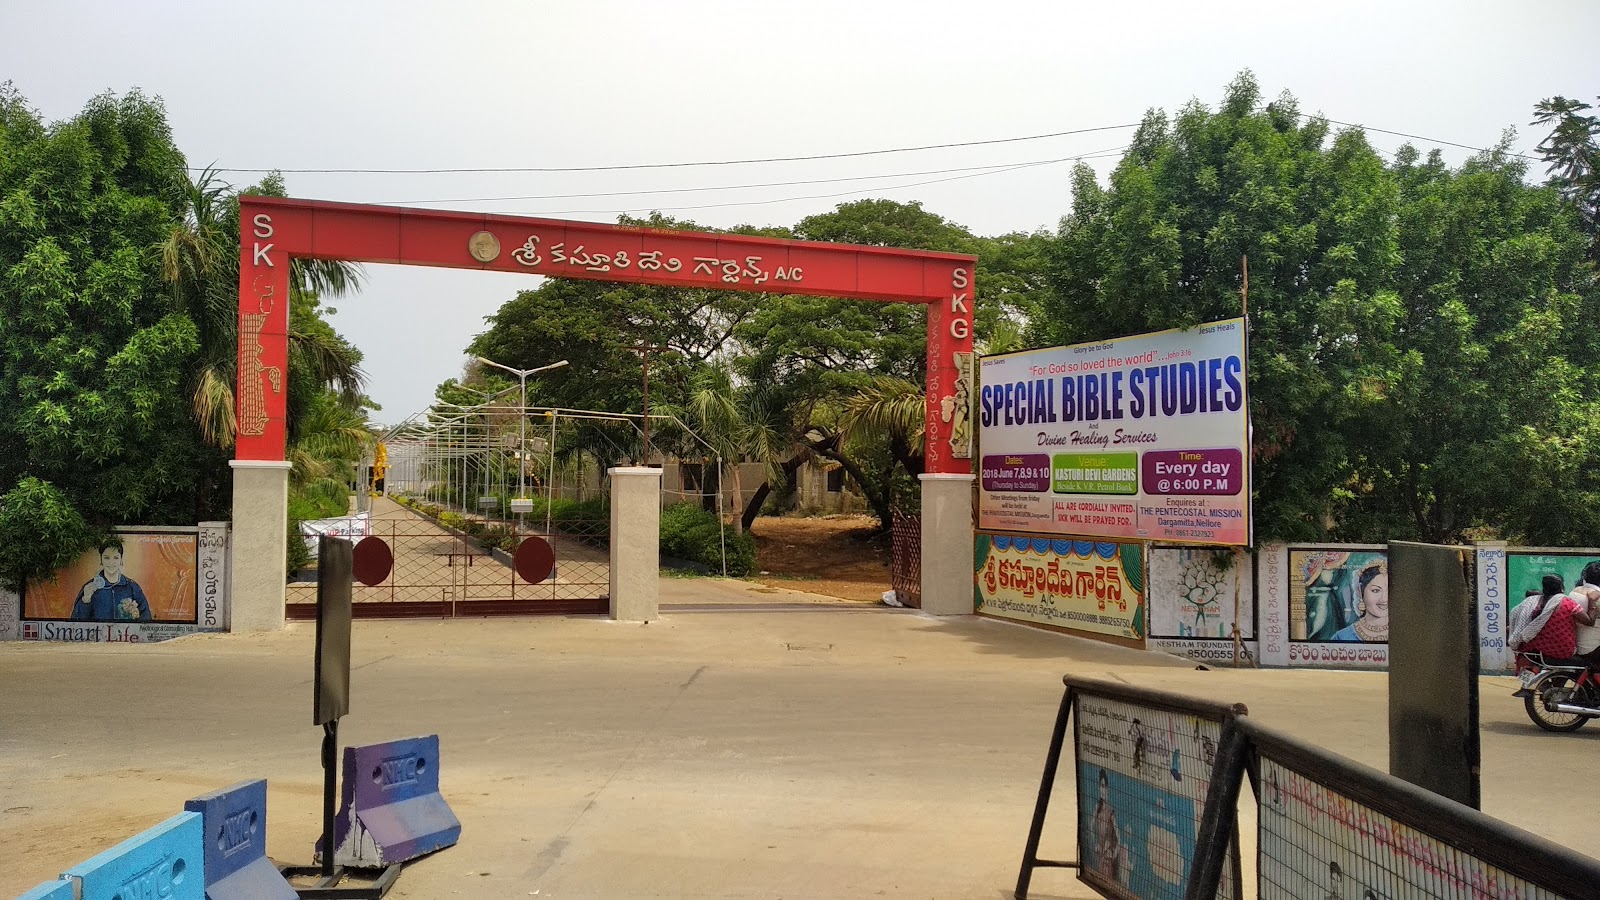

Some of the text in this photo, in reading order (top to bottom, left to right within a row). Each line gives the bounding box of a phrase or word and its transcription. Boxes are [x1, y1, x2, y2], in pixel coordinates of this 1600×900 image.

[511, 235, 542, 266] శ్రీ
[774, 266, 803, 281] A/C
[1199, 323, 1235, 335] Jesus Heals
[1074, 347, 1087, 355] Glory
[1048, 362, 1066, 374] God
[1069, 363, 1078, 372] so
[1081, 358, 1105, 371] loved
[1107, 357, 1123, 367] the
[1181, 349, 1192, 357] 3:16
[982, 355, 1242, 427] SPECIAL BIBLE STUDIES
[1037, 428, 1158, 449] Divine Healing Services
[1179, 452, 1204, 460] Time:
[982, 469, 999, 479] 2018
[999, 468, 1013, 479] June
[1039, 467, 1050, 479] 10
[1155, 460, 1230, 476] Every day
[1055, 468, 1136, 482] KASTURI DEVI GARDENS
[1097, 482, 1114, 491] Petrol
[1157, 479, 1228, 492] @ 6:00 P.M
[1055, 501, 1065, 510] ALL
[1066, 502, 1077, 511] ARE
[1078, 503, 1109, 512] CORDIALLY
[1166, 497, 1197, 507] Enquires
[1140, 506, 1242, 518] THE PENTECOSTAL MISSION
[1070, 514, 1083, 523] WILL
[1085, 515, 1092, 524] BE
[1093, 516, 1116, 525] PRAYED
[984, 555, 997, 595] శ్రీ
[1041, 593, 1055, 606] A/C
[1181, 605, 1220, 613] NESHAM
[44, 622, 102, 642] Smart
[106, 625, 139, 643] Life
[1196, 641, 1241, 649] FOUNDATI
[1187, 649, 1254, 659] 85005550
